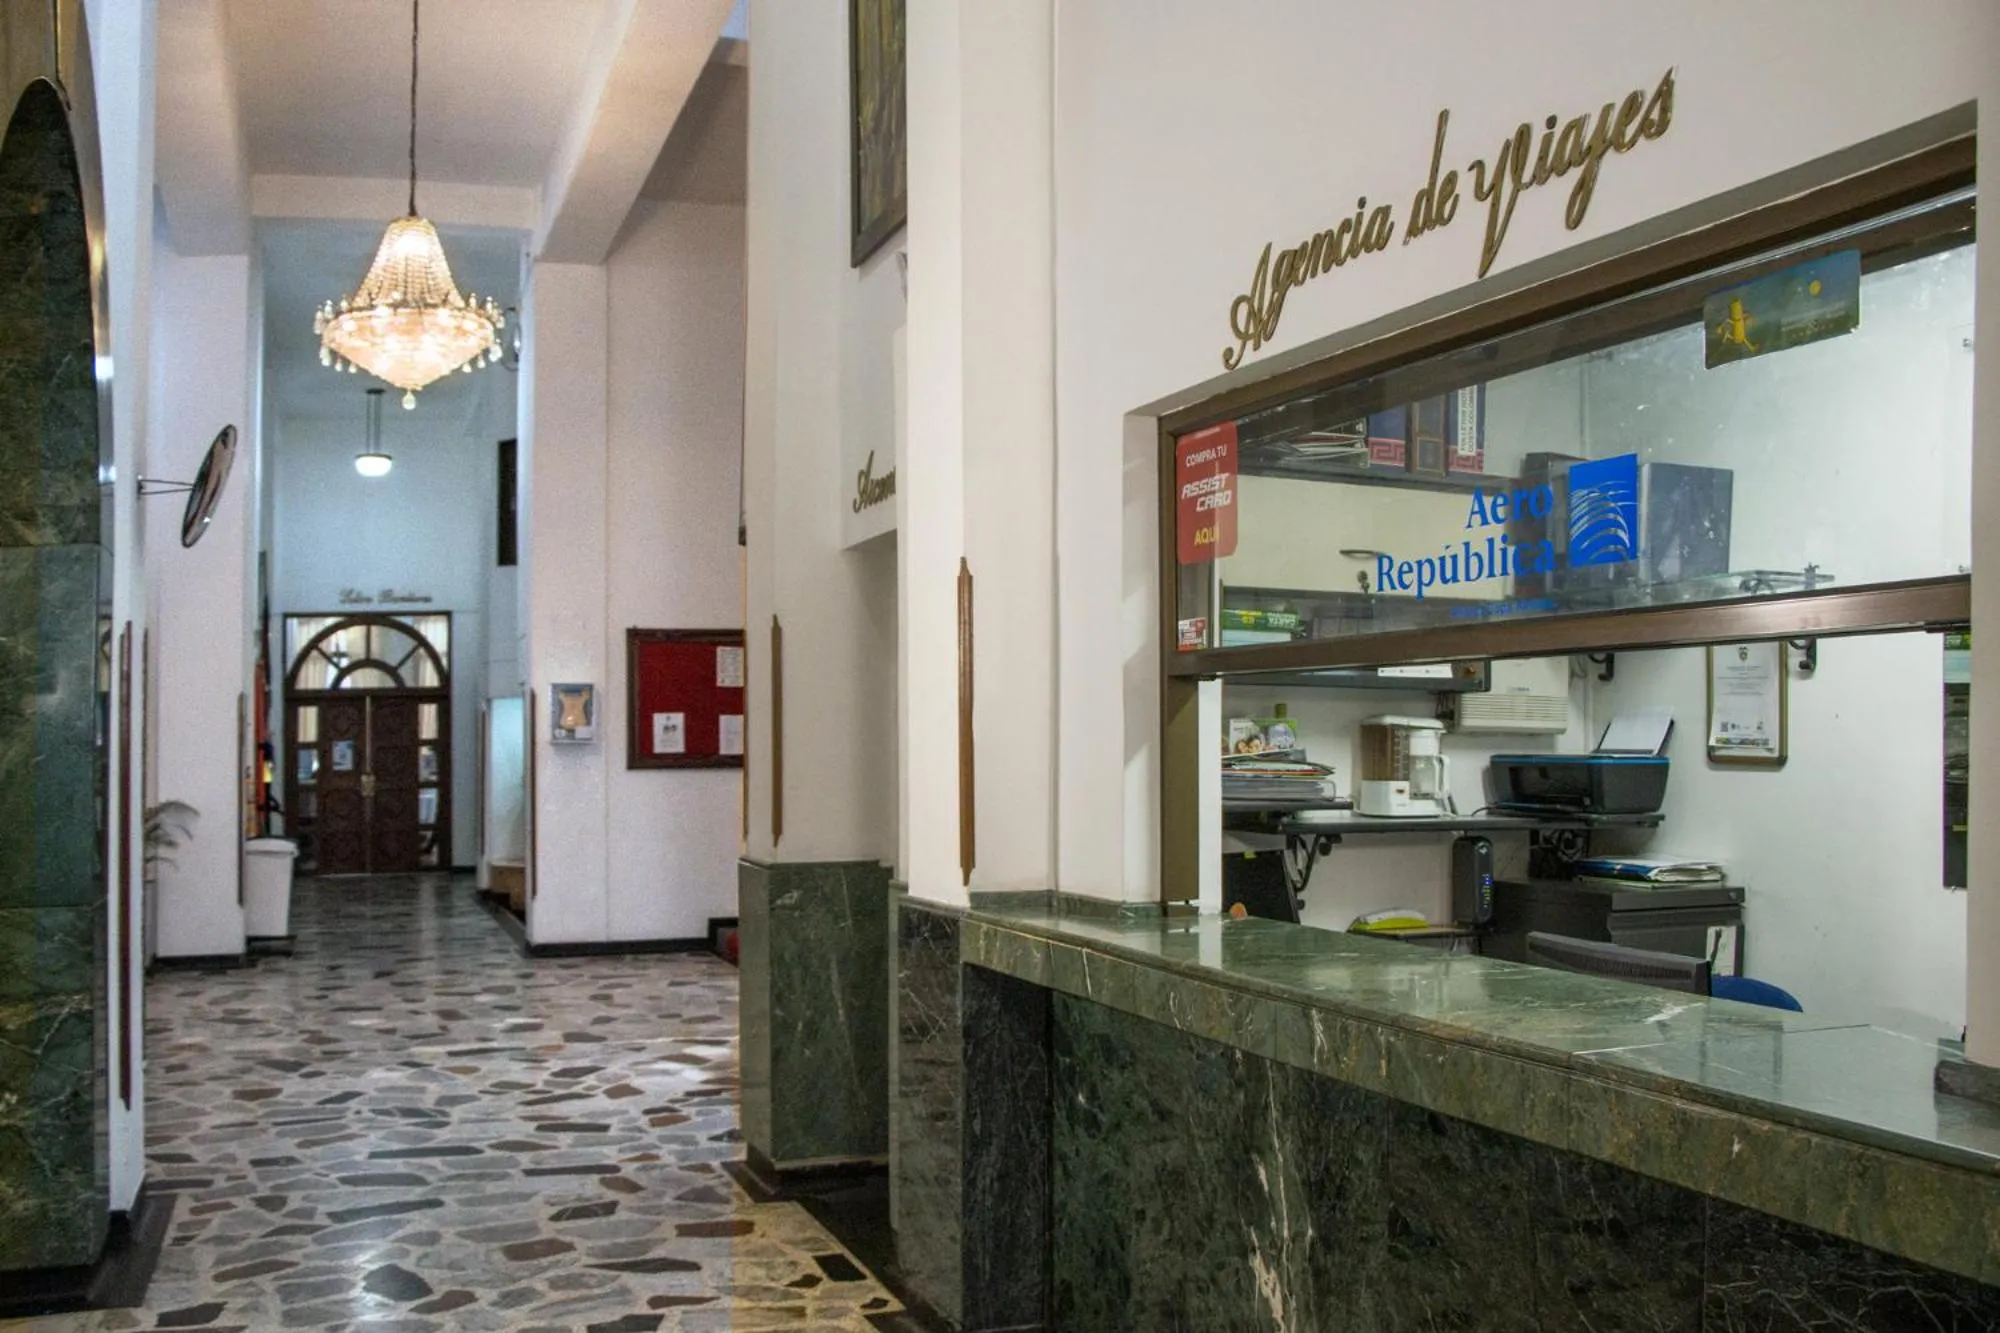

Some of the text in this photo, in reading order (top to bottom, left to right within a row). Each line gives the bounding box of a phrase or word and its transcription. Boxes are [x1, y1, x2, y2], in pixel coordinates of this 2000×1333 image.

[1222, 66, 1676, 371] Agencia de Viajes
[1185, 443, 1228, 468] COMPRA TU
[1181, 472, 1230, 500] ASSIST
[1195, 490, 1233, 513] CARD
[1464, 484, 1553, 529] Aero
[1376, 533, 1556, 599] República
